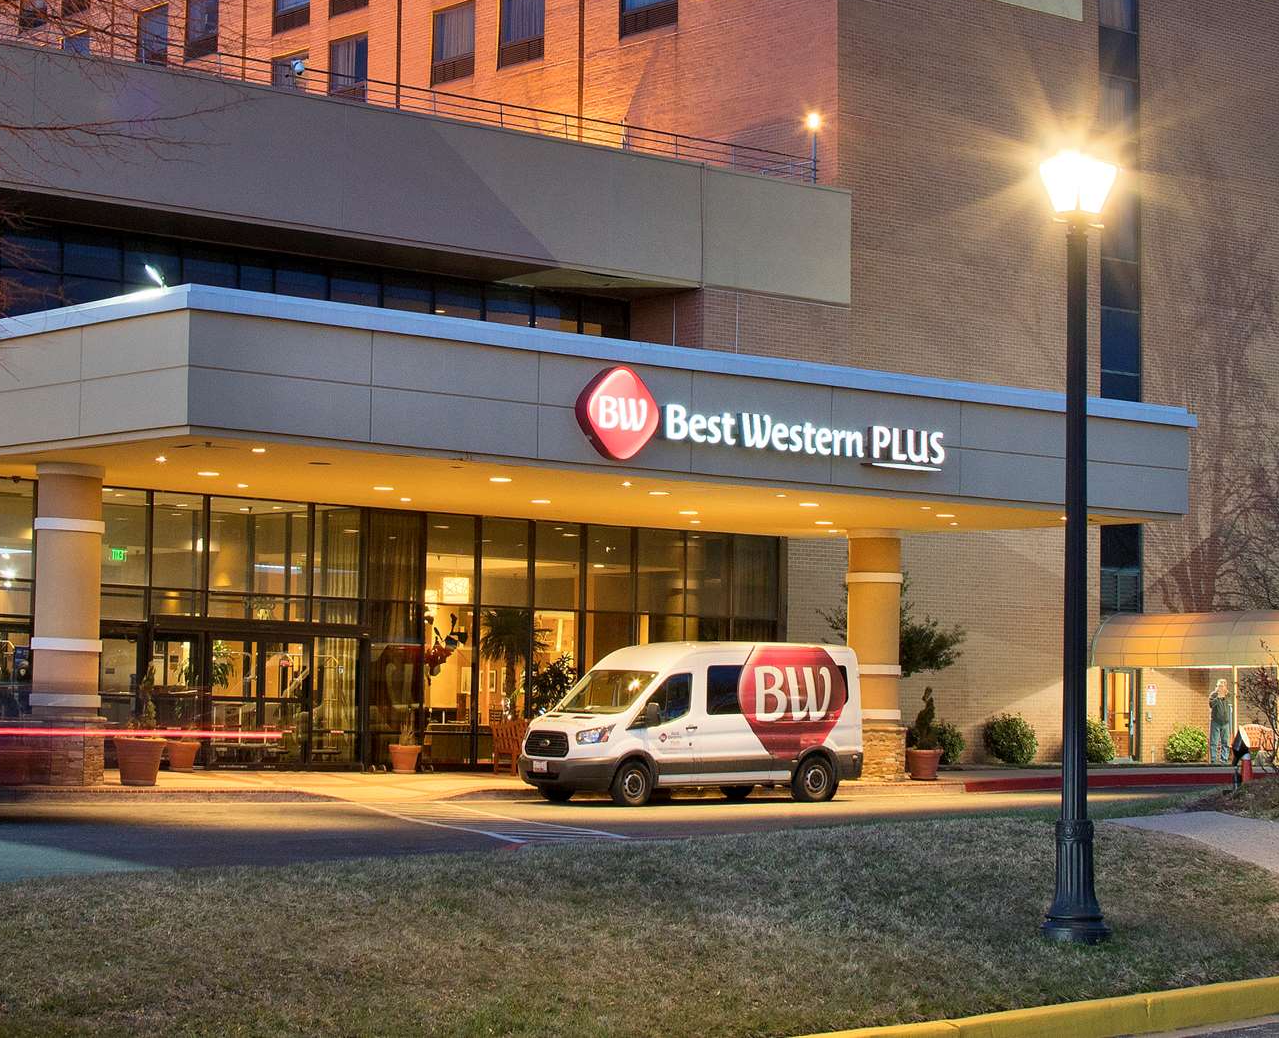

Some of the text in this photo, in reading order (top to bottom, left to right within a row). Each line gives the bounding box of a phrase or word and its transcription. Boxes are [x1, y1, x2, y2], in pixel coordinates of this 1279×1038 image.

[598, 395, 648, 432] BW
[665, 403, 945, 465] Best Western PLUS
[754, 665, 832, 722] BW
